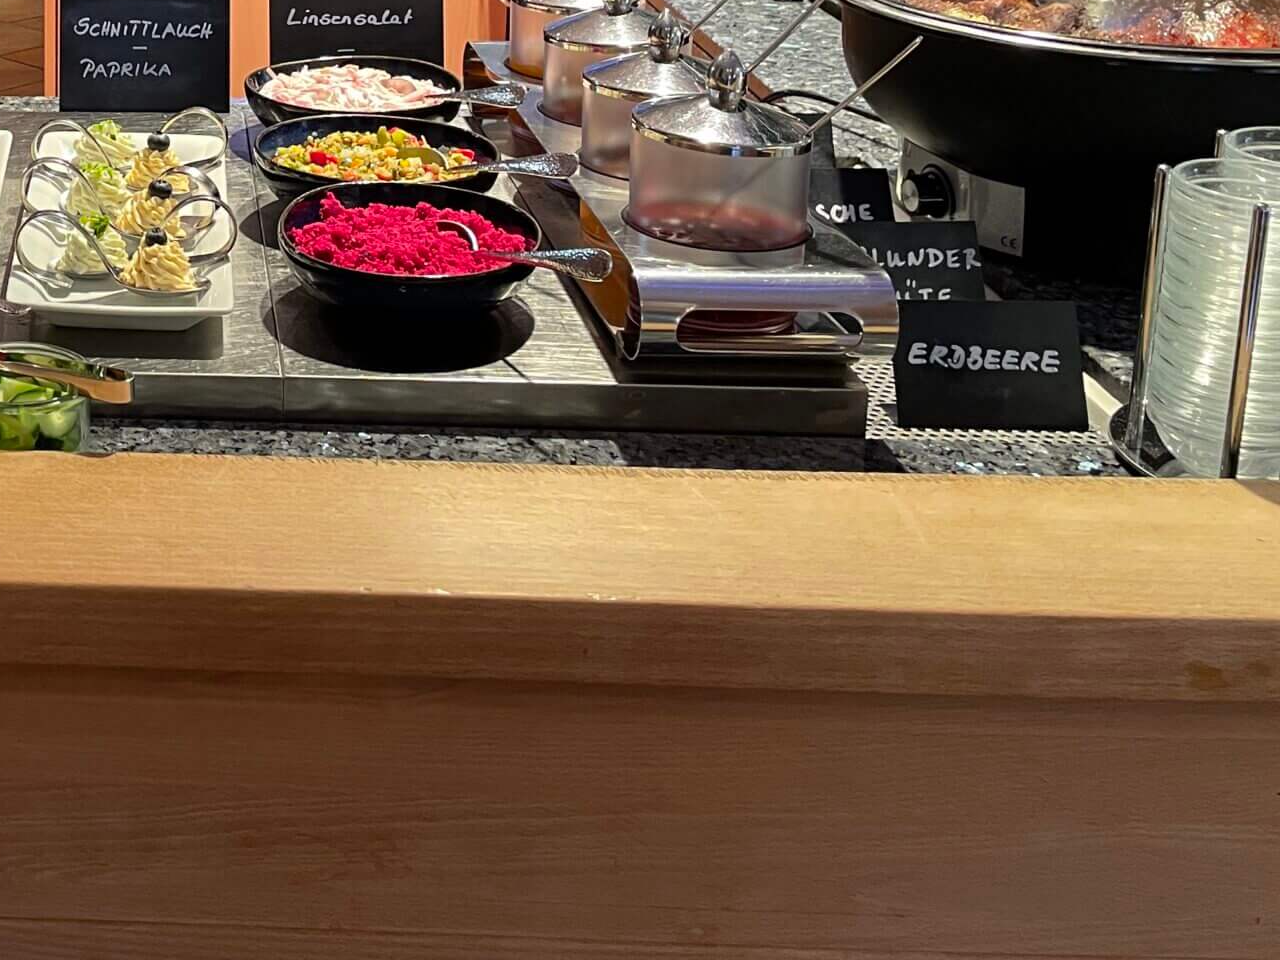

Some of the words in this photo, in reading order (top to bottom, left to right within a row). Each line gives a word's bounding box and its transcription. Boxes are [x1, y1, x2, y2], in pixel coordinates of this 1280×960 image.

[286, 8, 414, 26] Linsensalat
[73, 17, 214, 39] SCHNITTLAUCH
[79, 58, 172, 79] PAPRIKA
[1000, 236, 1018, 249] CE
[907, 342, 1061, 374] ERDBEERE
